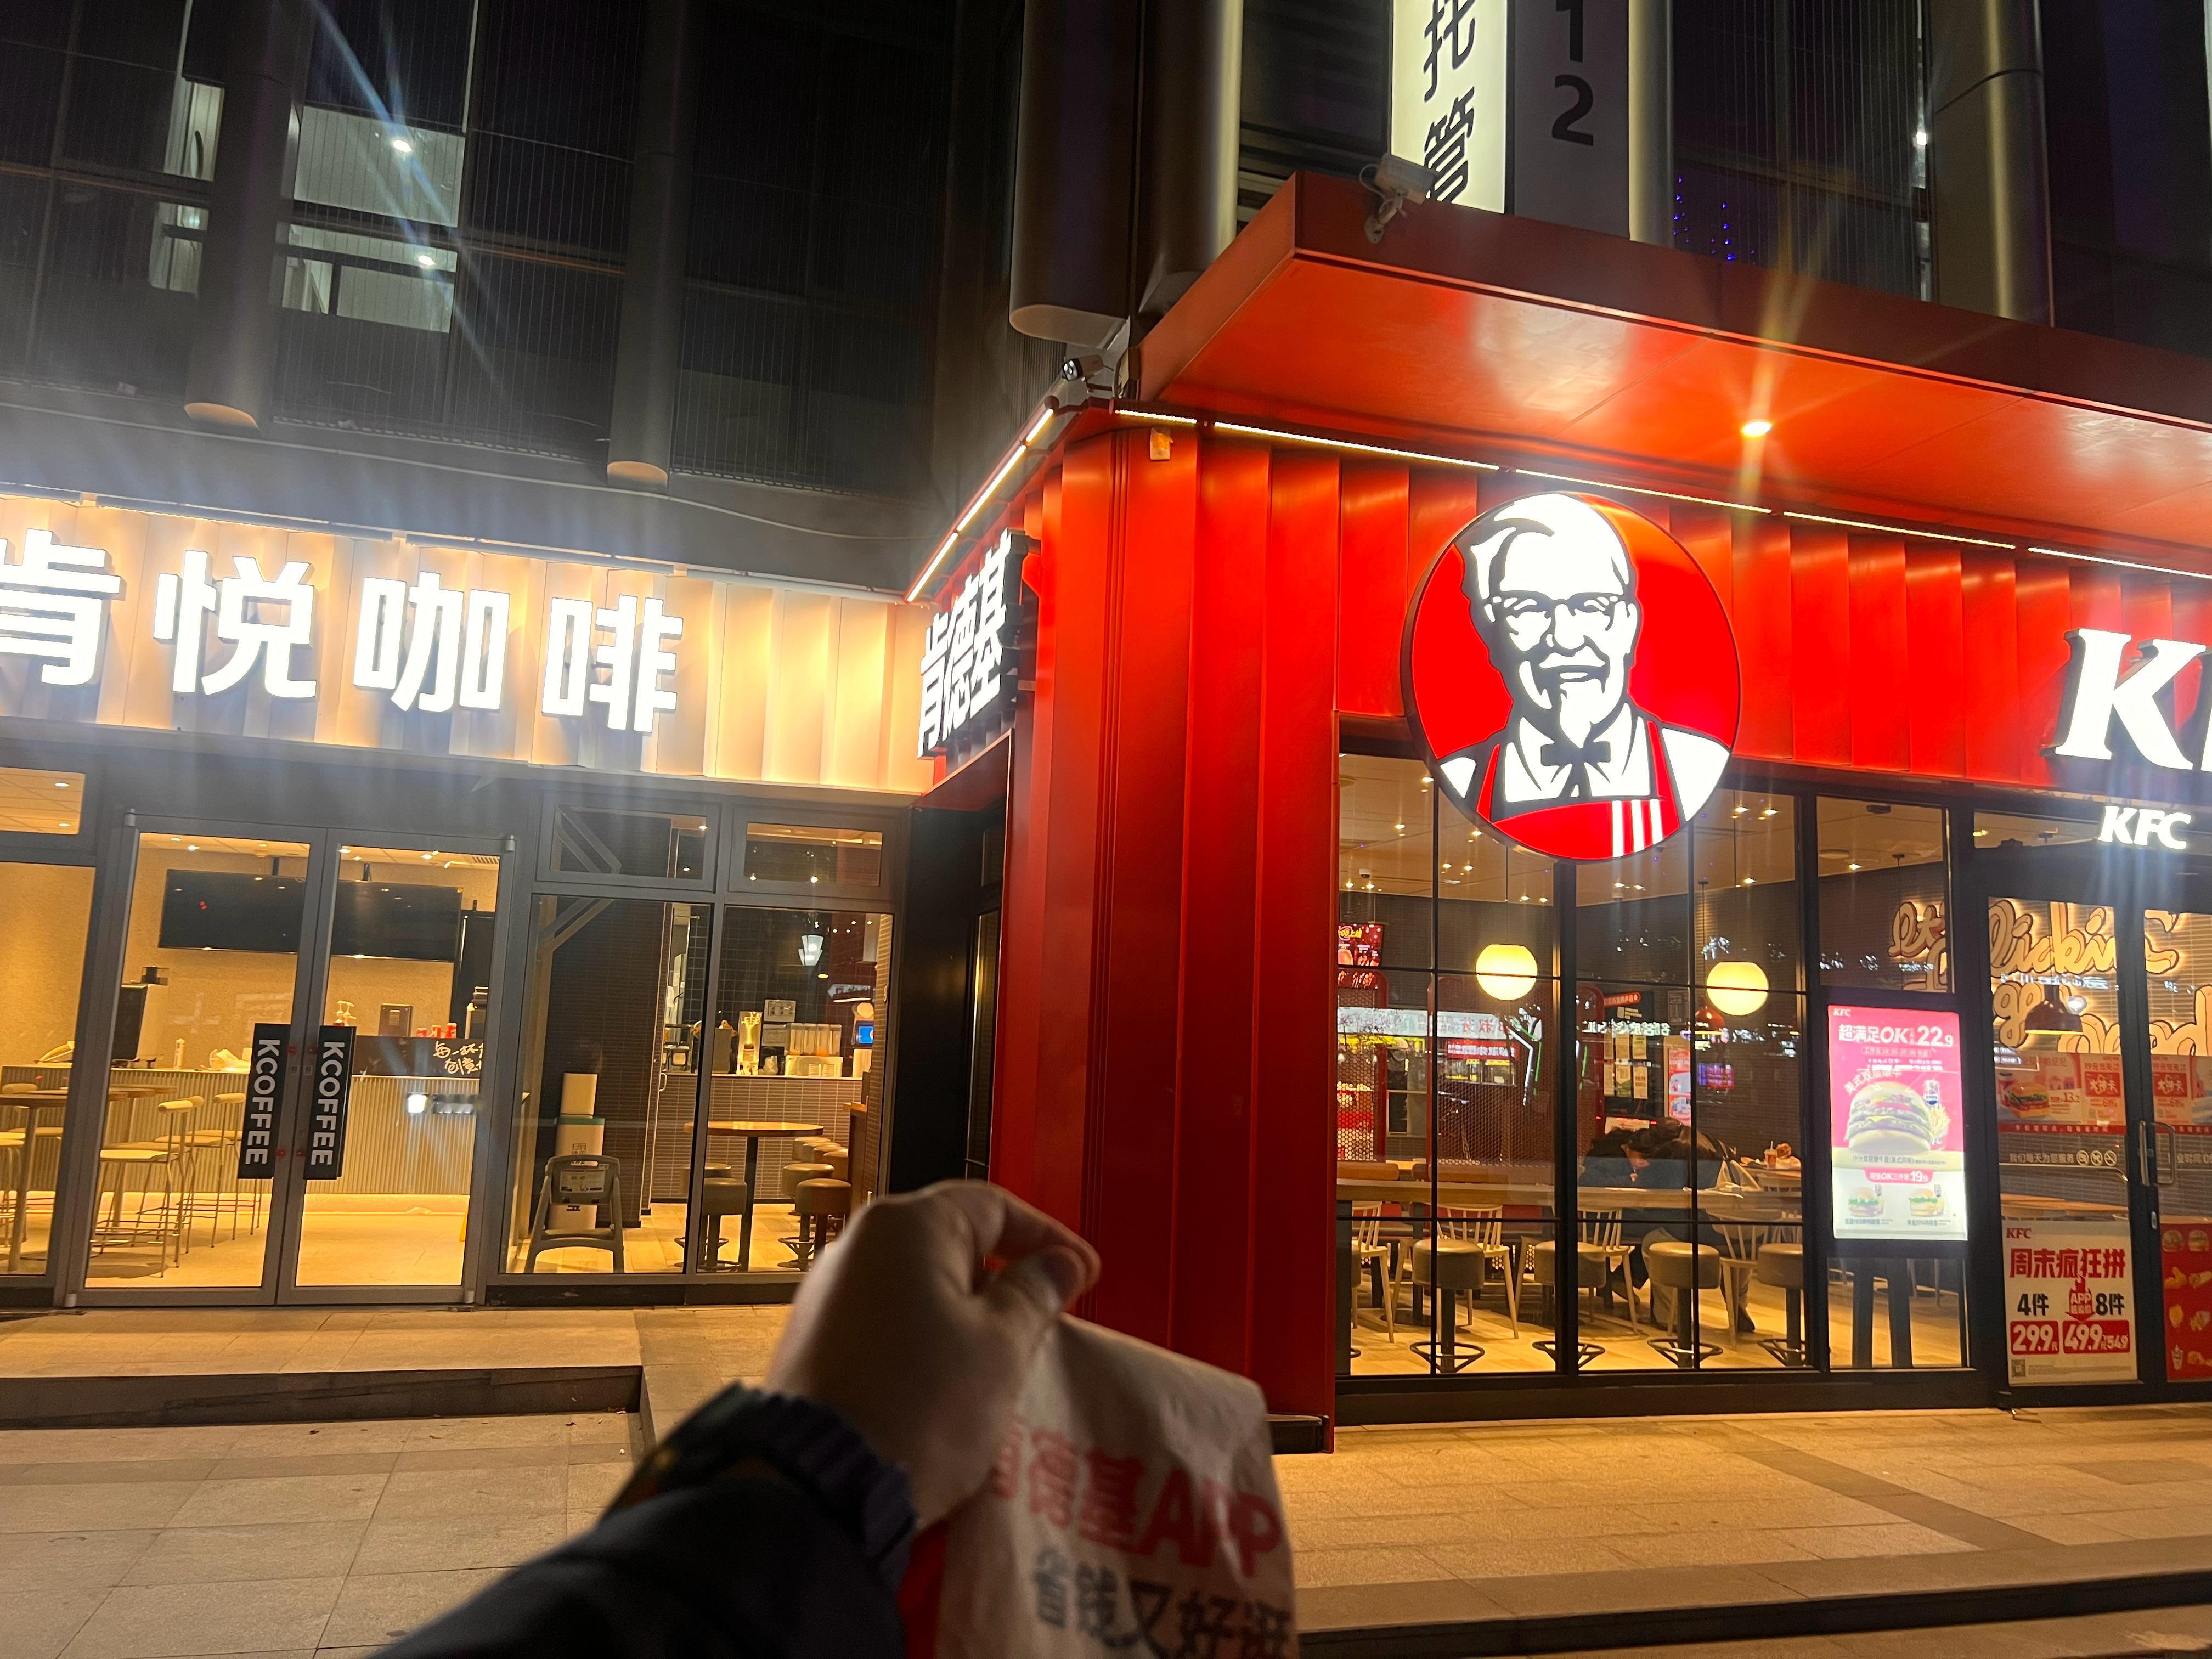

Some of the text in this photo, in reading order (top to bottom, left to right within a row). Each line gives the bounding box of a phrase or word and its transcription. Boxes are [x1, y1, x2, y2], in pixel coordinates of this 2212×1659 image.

[0, 528, 684, 734] 肯悦咖啡
[917, 527, 1013, 760] 肯德基
[2055, 628, 2212, 772] K
[2097, 805, 2192, 850] KFC
[1833, 1008, 1851, 1017] KFC
[1917, 1025, 1954, 1047] 22.9
[245, 1039, 281, 1164] KCOFFEE
[311, 1041, 345, 1165] KCOFFEE
[2006, 1228, 2031, 1239] KFC
[2010, 1248, 2126, 1278] 周末疯狂拼
[2017, 1293, 2049, 1316] 4件
[2070, 1293, 2091, 1305] APP
[2096, 1293, 2125, 1315] 8件
